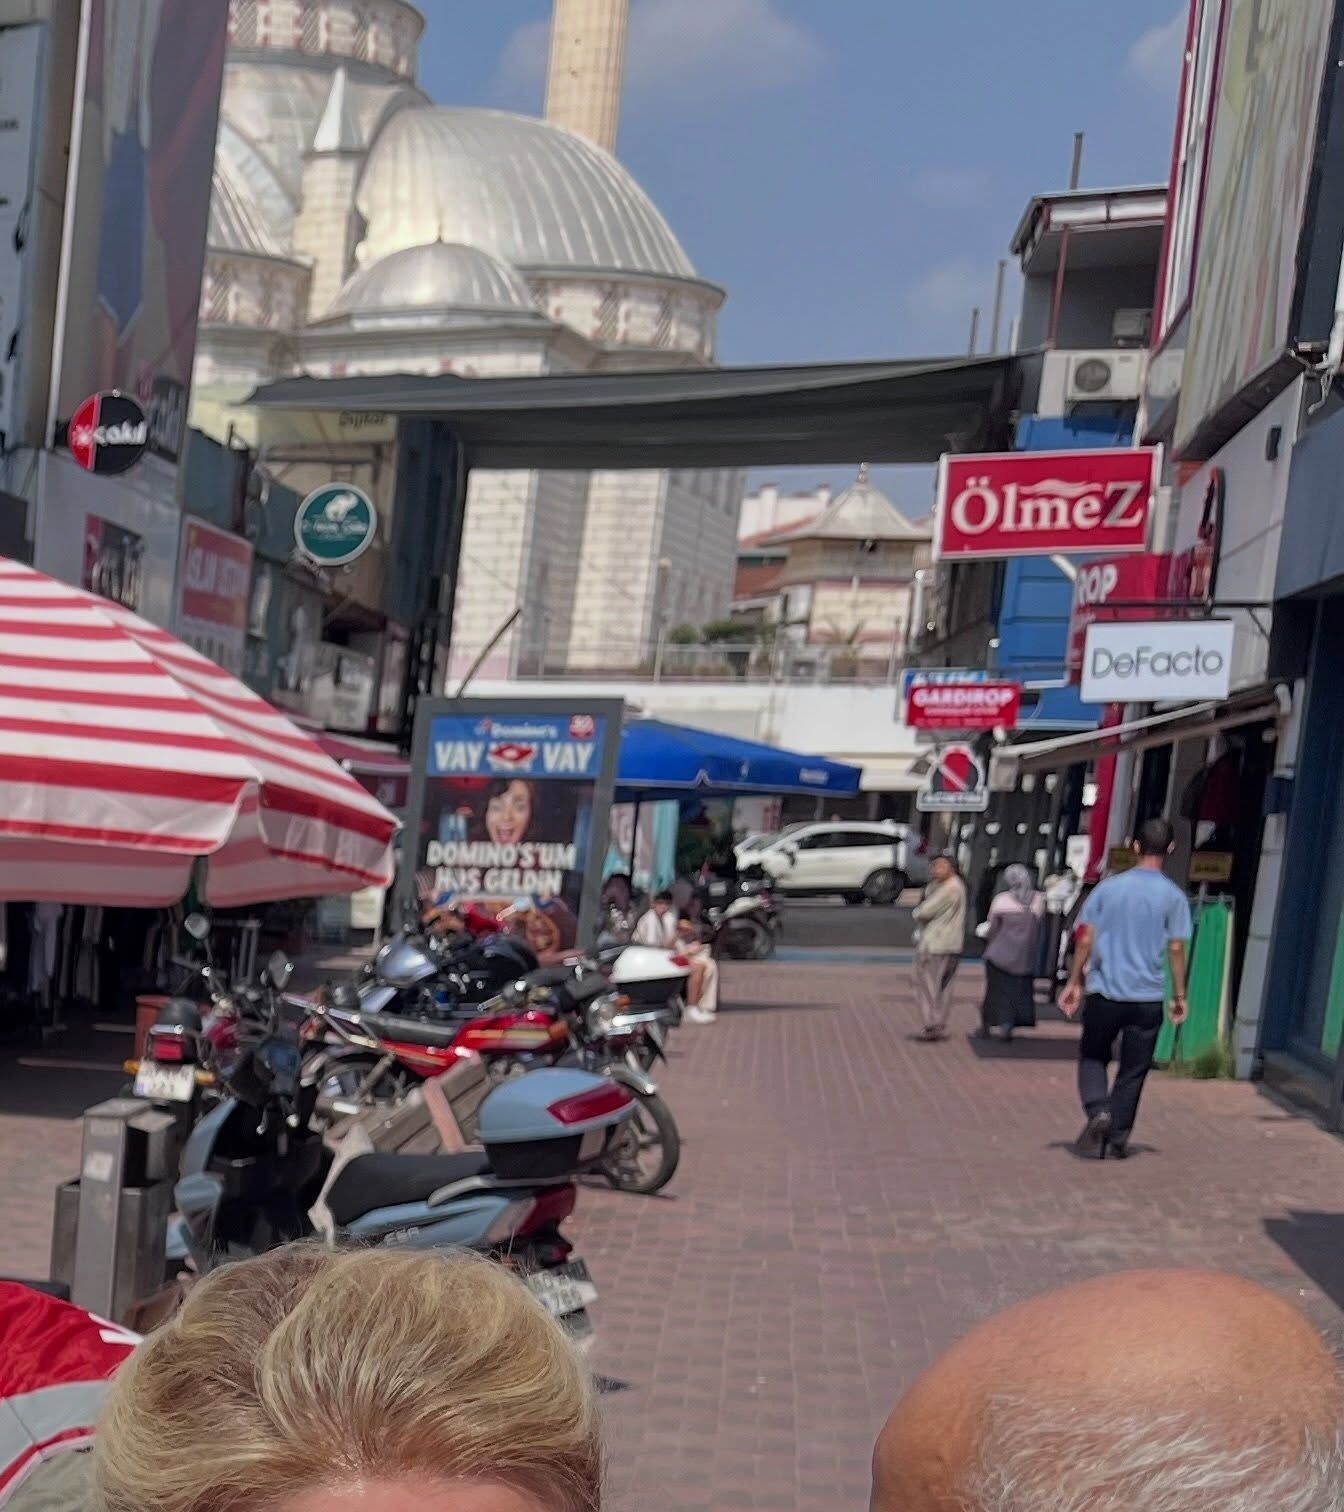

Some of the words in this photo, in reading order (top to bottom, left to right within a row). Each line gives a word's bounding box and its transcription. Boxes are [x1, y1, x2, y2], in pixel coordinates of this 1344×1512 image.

[1091, 645, 1224, 679] DeFacto
[435, 741, 485, 772] VAY
[543, 741, 596, 773] VAY
